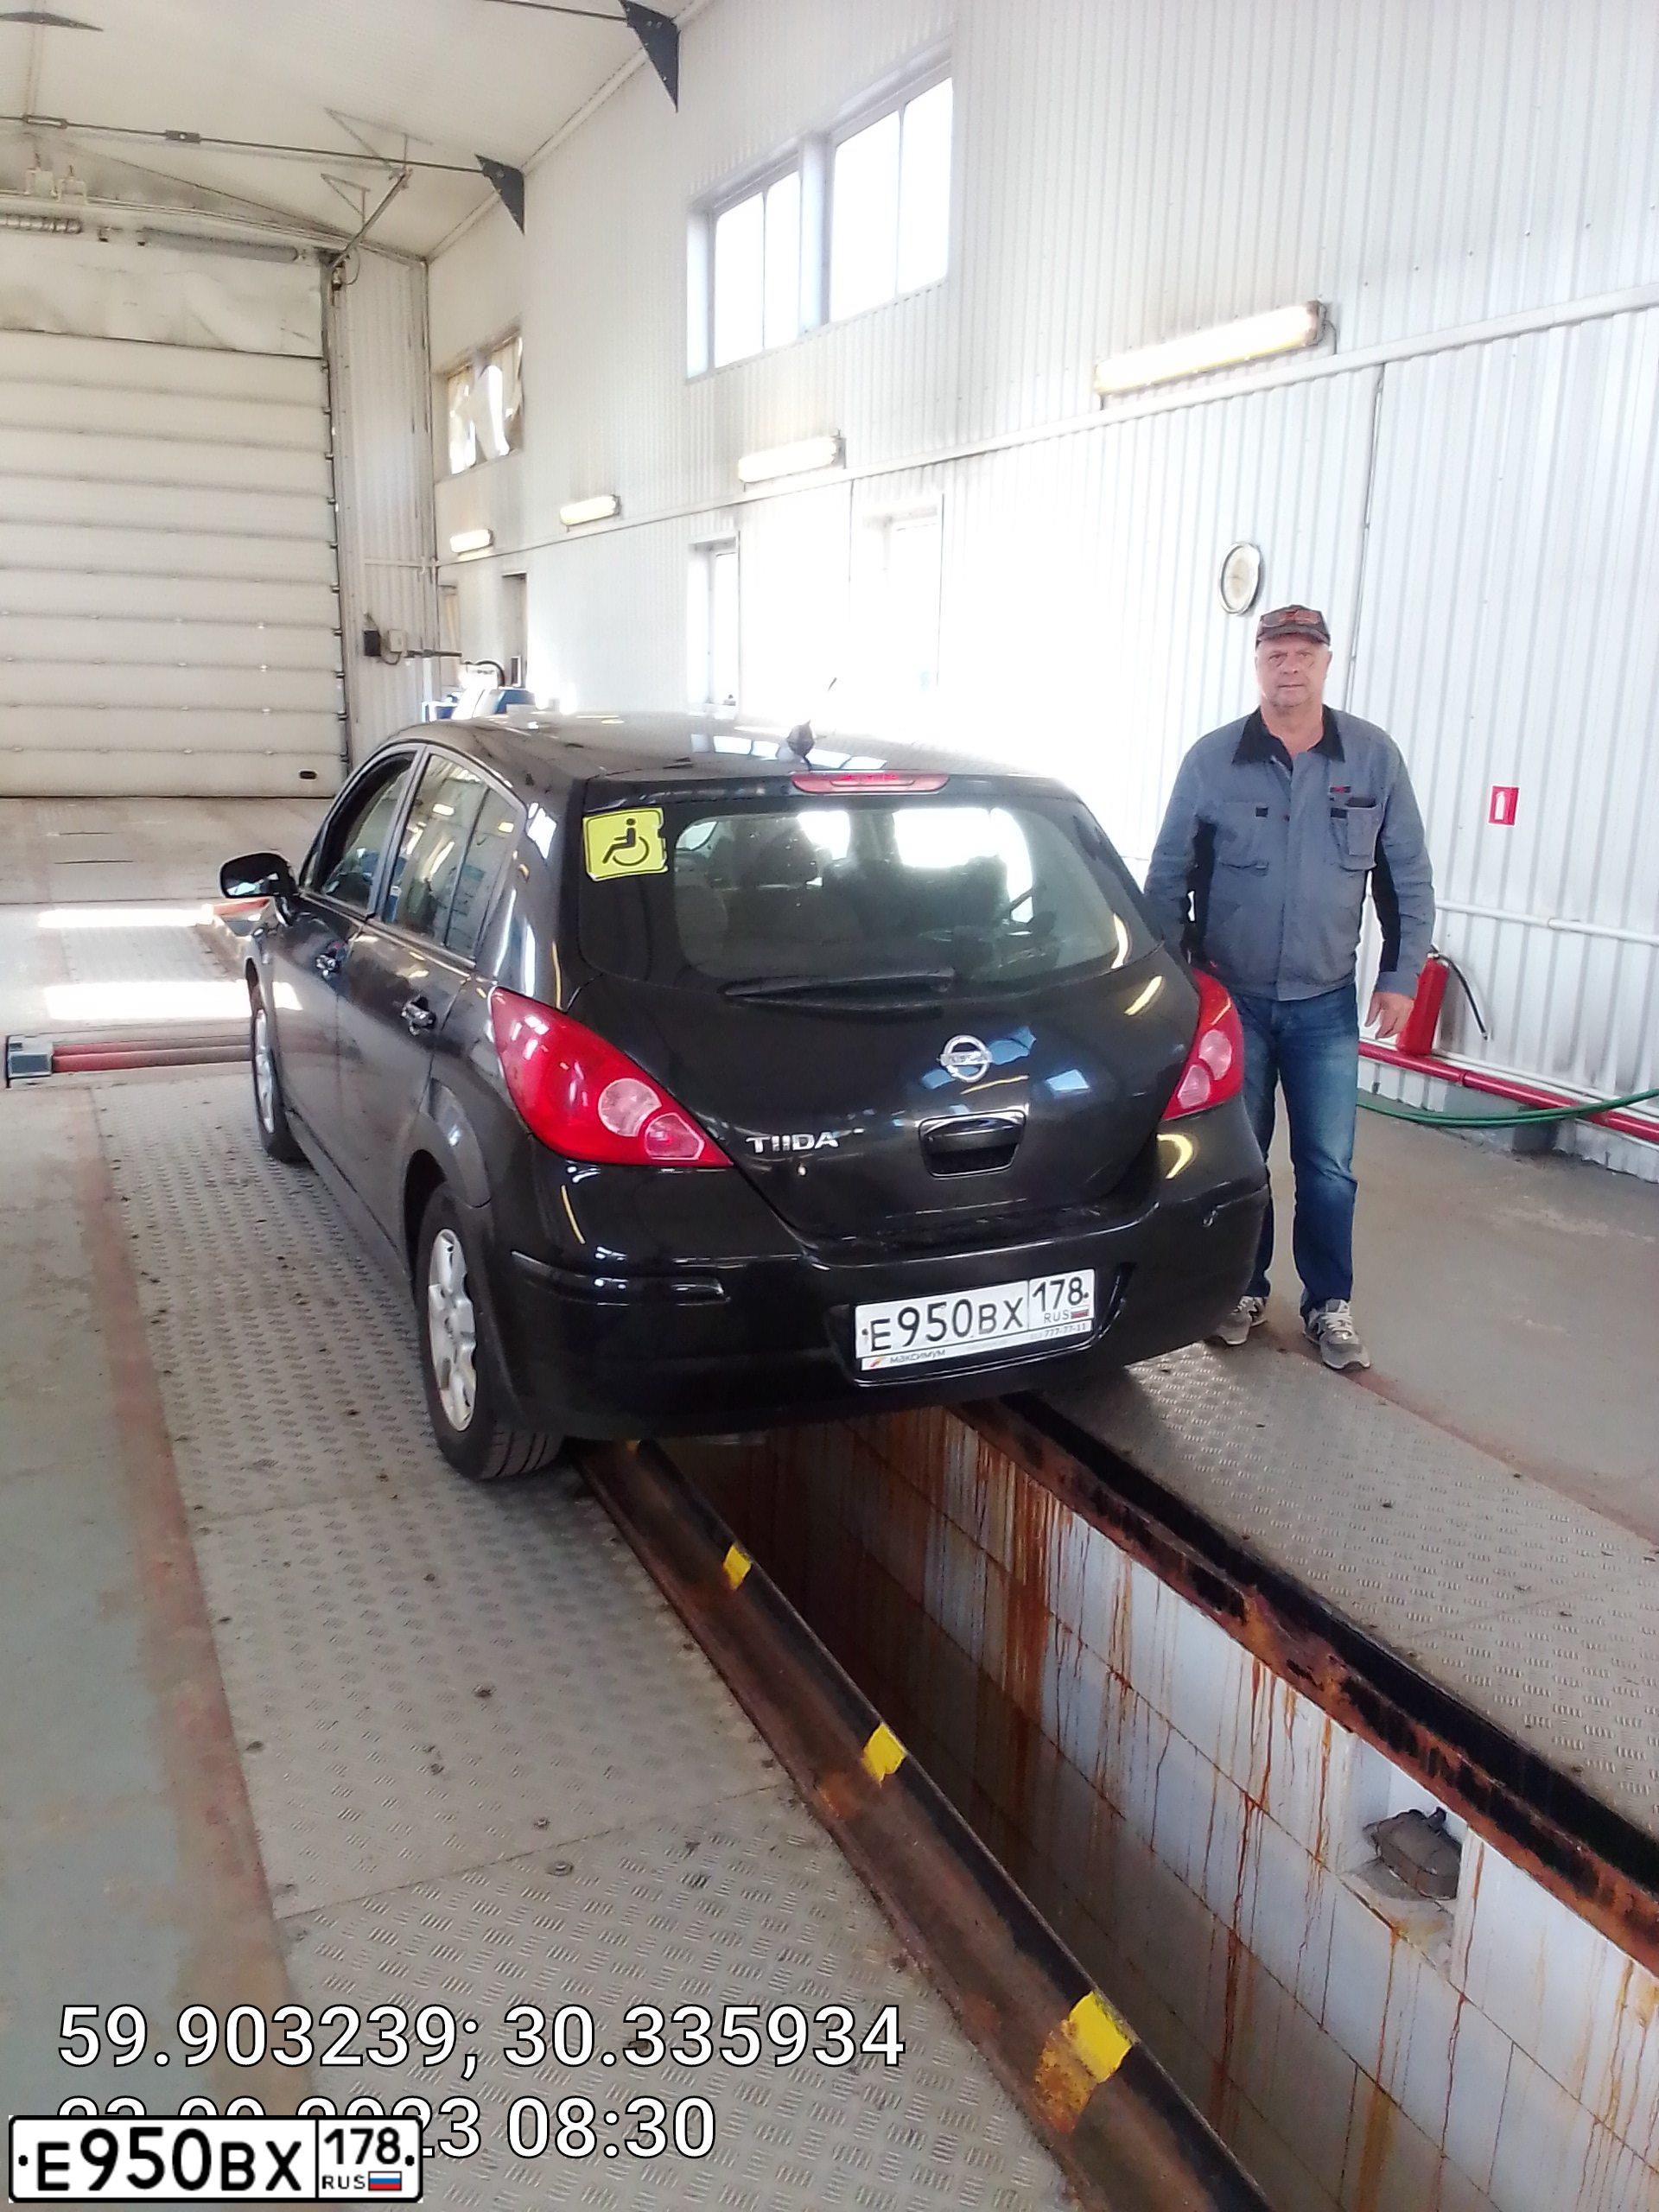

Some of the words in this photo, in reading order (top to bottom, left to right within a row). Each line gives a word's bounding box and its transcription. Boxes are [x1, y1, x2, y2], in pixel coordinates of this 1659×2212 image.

[746, 1131, 839, 1154] TIIDA
[1032, 1276, 1084, 1313] 178
[1043, 1309, 1070, 1323] RUS
